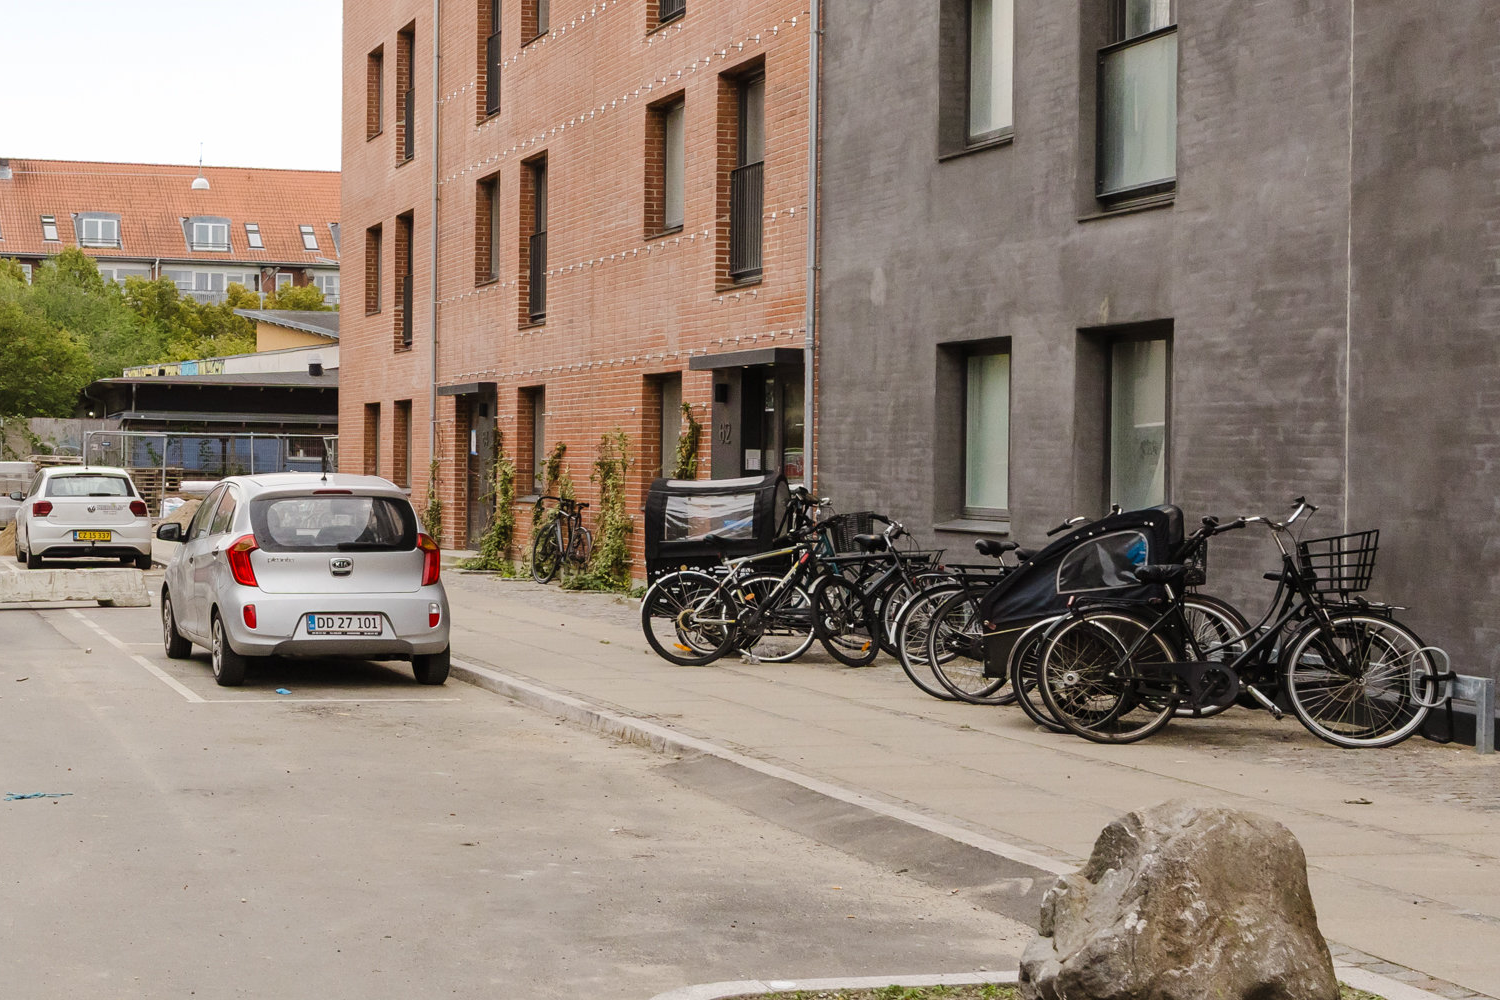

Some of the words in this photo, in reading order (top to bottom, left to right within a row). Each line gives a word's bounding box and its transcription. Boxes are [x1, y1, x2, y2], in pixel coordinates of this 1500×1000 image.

[317, 617, 334, 629] DD
[337, 617, 353, 629] 27
[357, 617, 378, 629] 101
